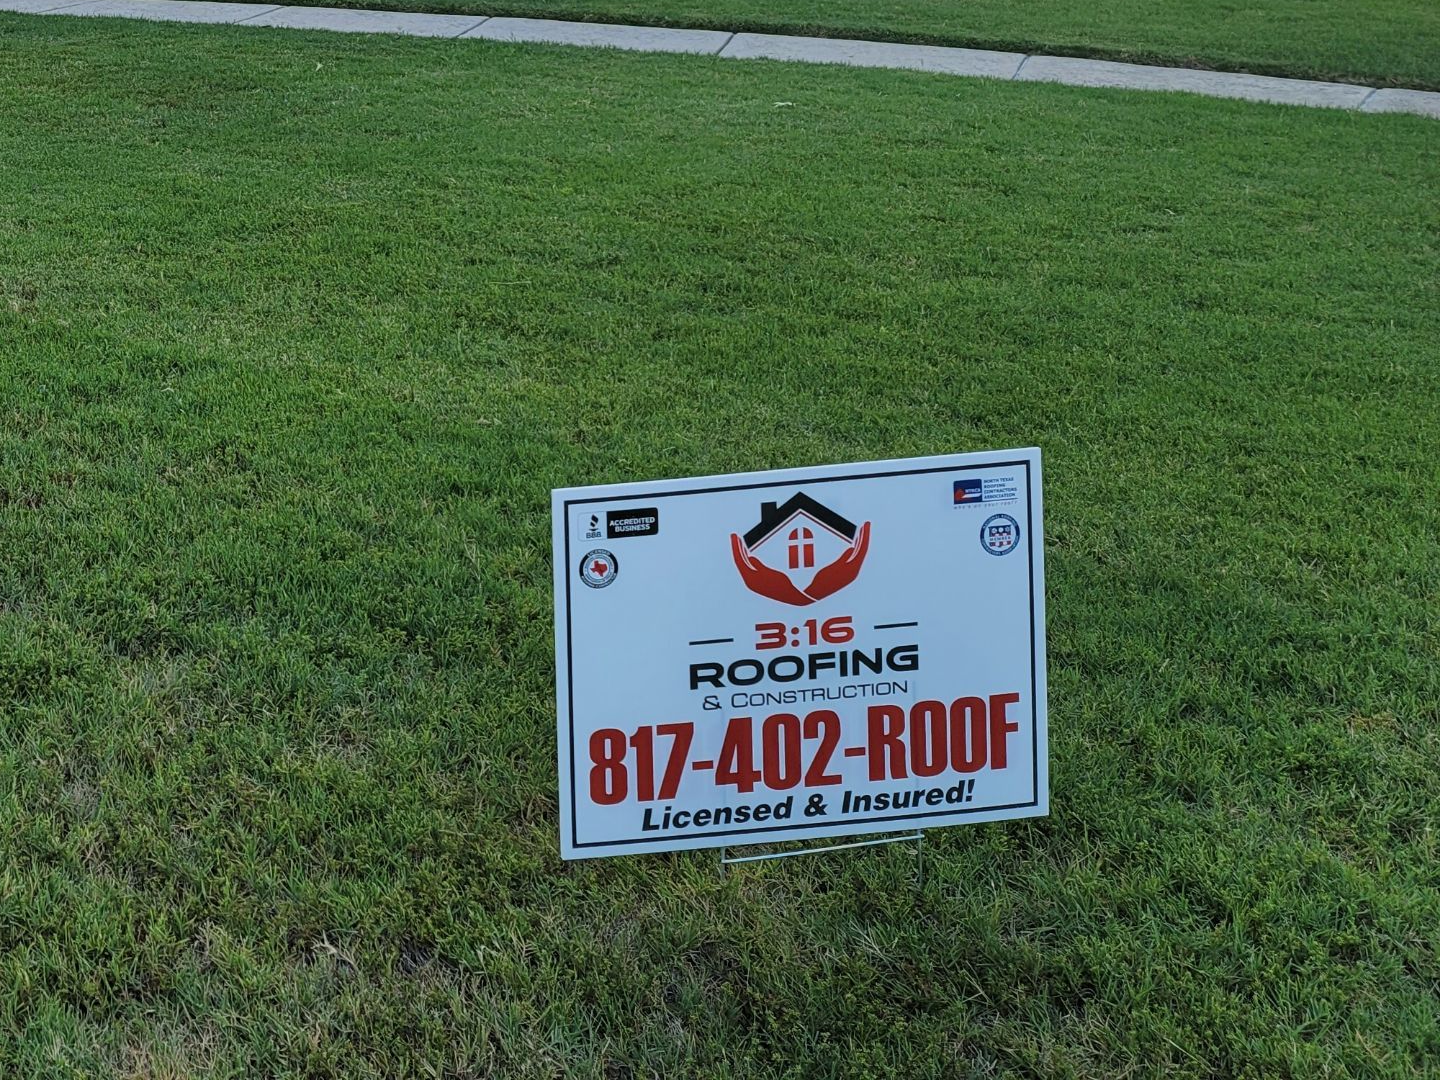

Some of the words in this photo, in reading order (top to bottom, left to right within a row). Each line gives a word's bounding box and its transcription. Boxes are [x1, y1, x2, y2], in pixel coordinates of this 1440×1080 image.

[585, 531, 602, 539] BBB
[609, 516, 656, 527] ACCREDITED
[614, 523, 651, 533] BUSINESS
[755, 615, 855, 651] 3:16
[689, 644, 920, 691] ROOFING
[702, 695, 723, 711] &
[731, 680, 909, 709] CONSTRUCTION
[589, 692, 1020, 806] 817-402-ROOF
[641, 795, 794, 832] Licensed
[803, 792, 828, 818] &
[841, 778, 976, 814] Insured!
